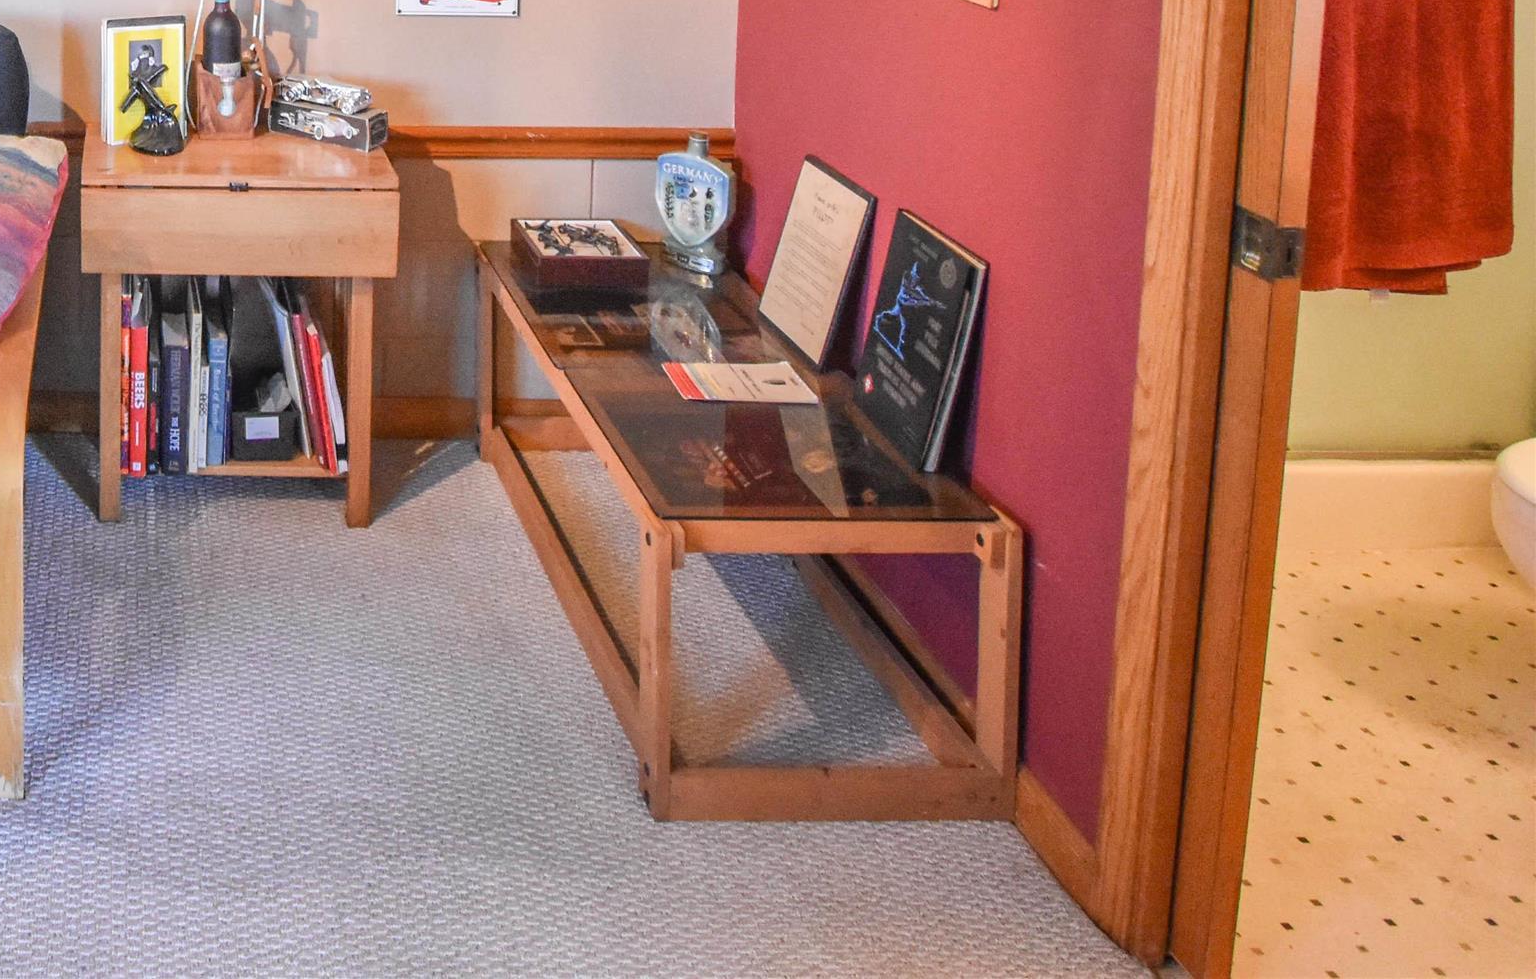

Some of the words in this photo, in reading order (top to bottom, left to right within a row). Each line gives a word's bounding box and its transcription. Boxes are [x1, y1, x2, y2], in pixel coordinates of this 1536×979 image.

[662, 162, 724, 185] GERMANY
[134, 372, 145, 409] BEERS
[169, 428, 180, 452] HOPE
